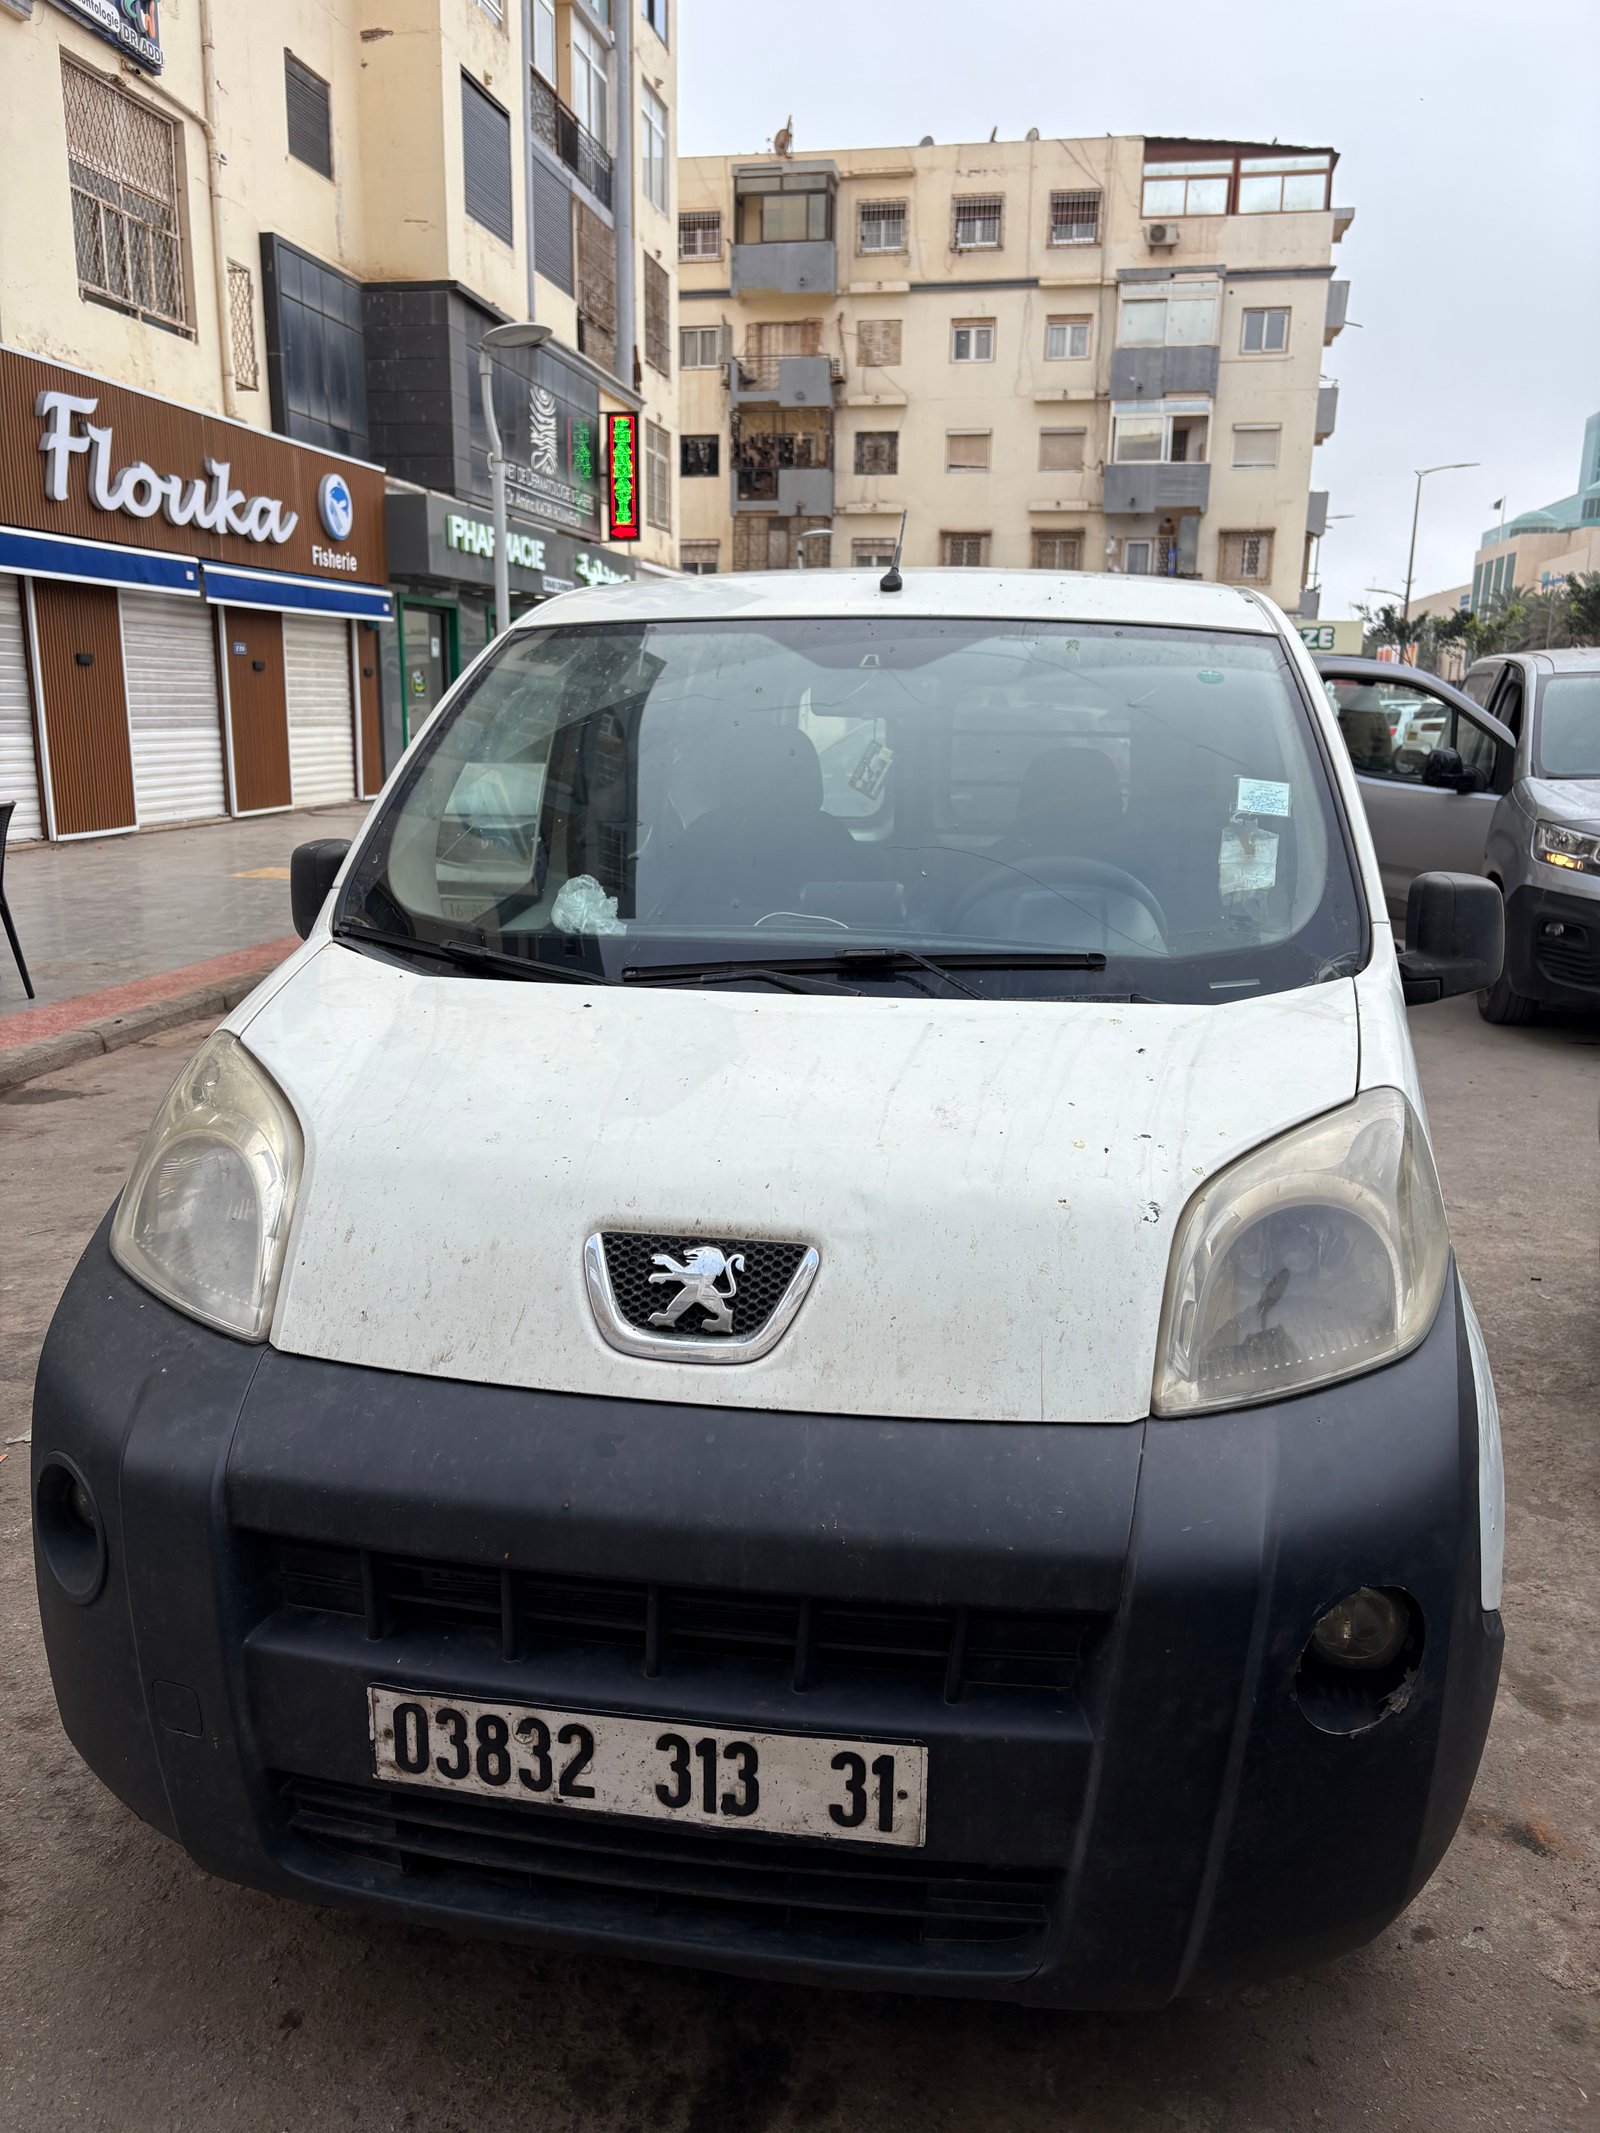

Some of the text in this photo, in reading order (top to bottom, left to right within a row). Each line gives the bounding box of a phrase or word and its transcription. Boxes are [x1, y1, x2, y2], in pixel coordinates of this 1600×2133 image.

[80, 0, 119, 28] ontologie
[36, 391, 299, 543] Flouka
[312, 545, 357, 572] Fisherie
[1297, 626, 1335, 650] ZE
[392, 1702, 896, 1833] 03832 313 31
